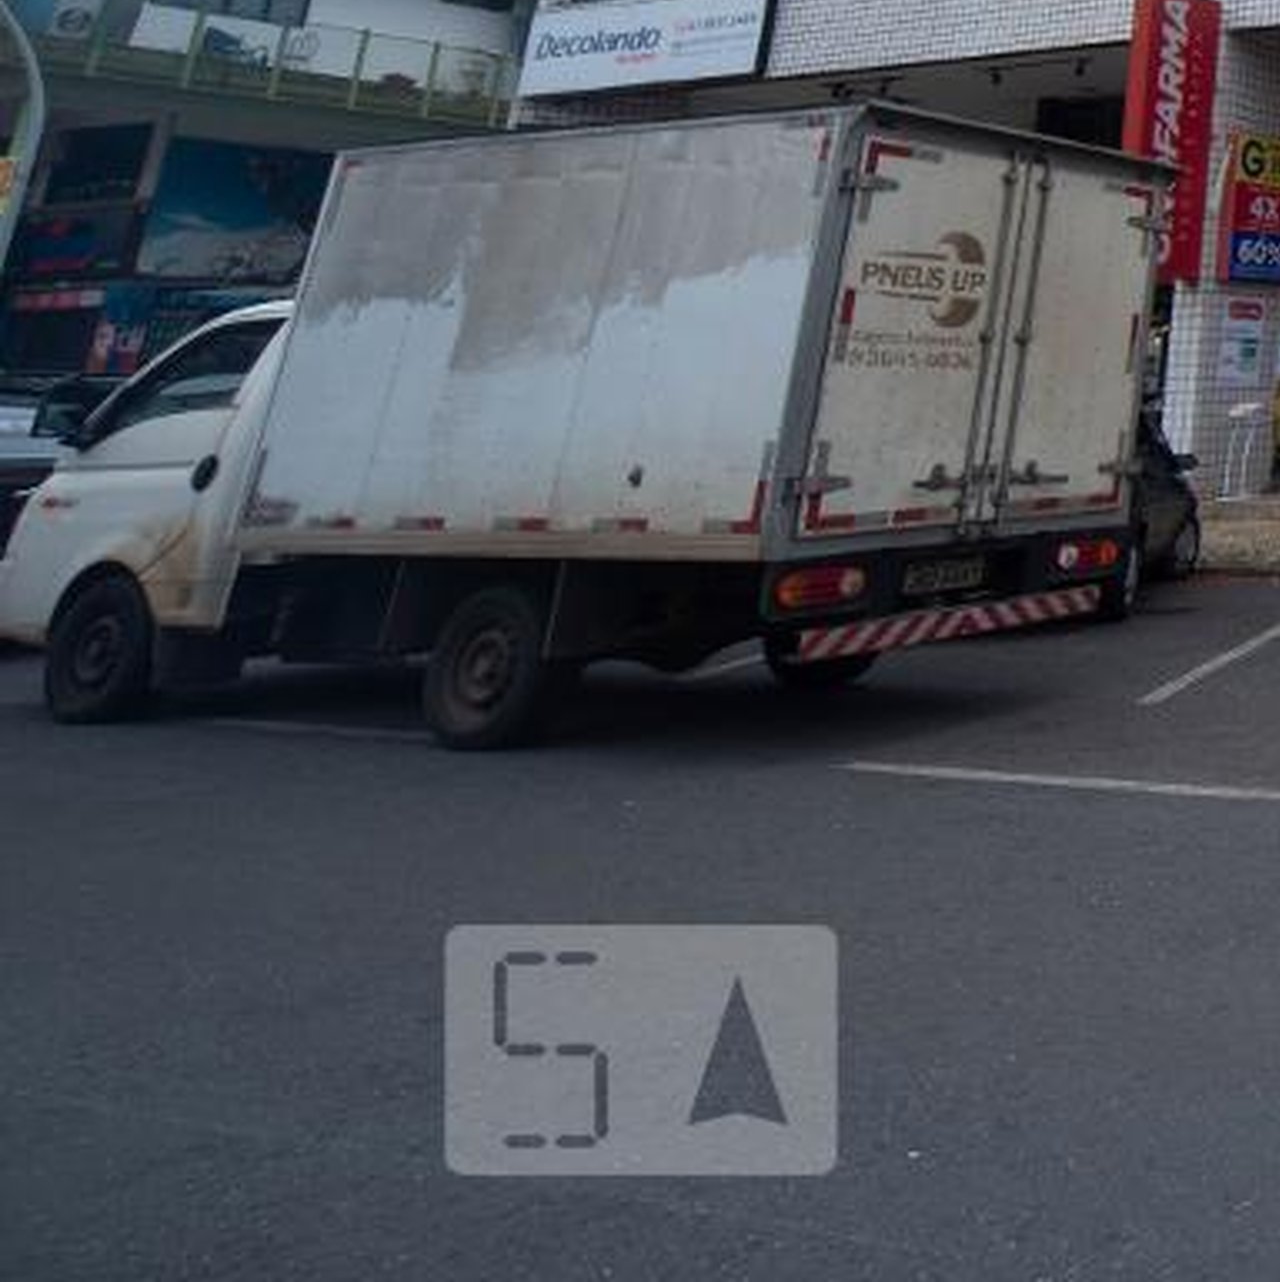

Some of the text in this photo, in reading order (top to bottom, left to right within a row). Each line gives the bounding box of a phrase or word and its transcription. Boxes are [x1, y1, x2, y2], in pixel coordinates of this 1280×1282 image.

[535, 26, 663, 61] Decolando
[1241, 140, 1266, 177] G
[861, 261, 987, 294] PNEUS UP
